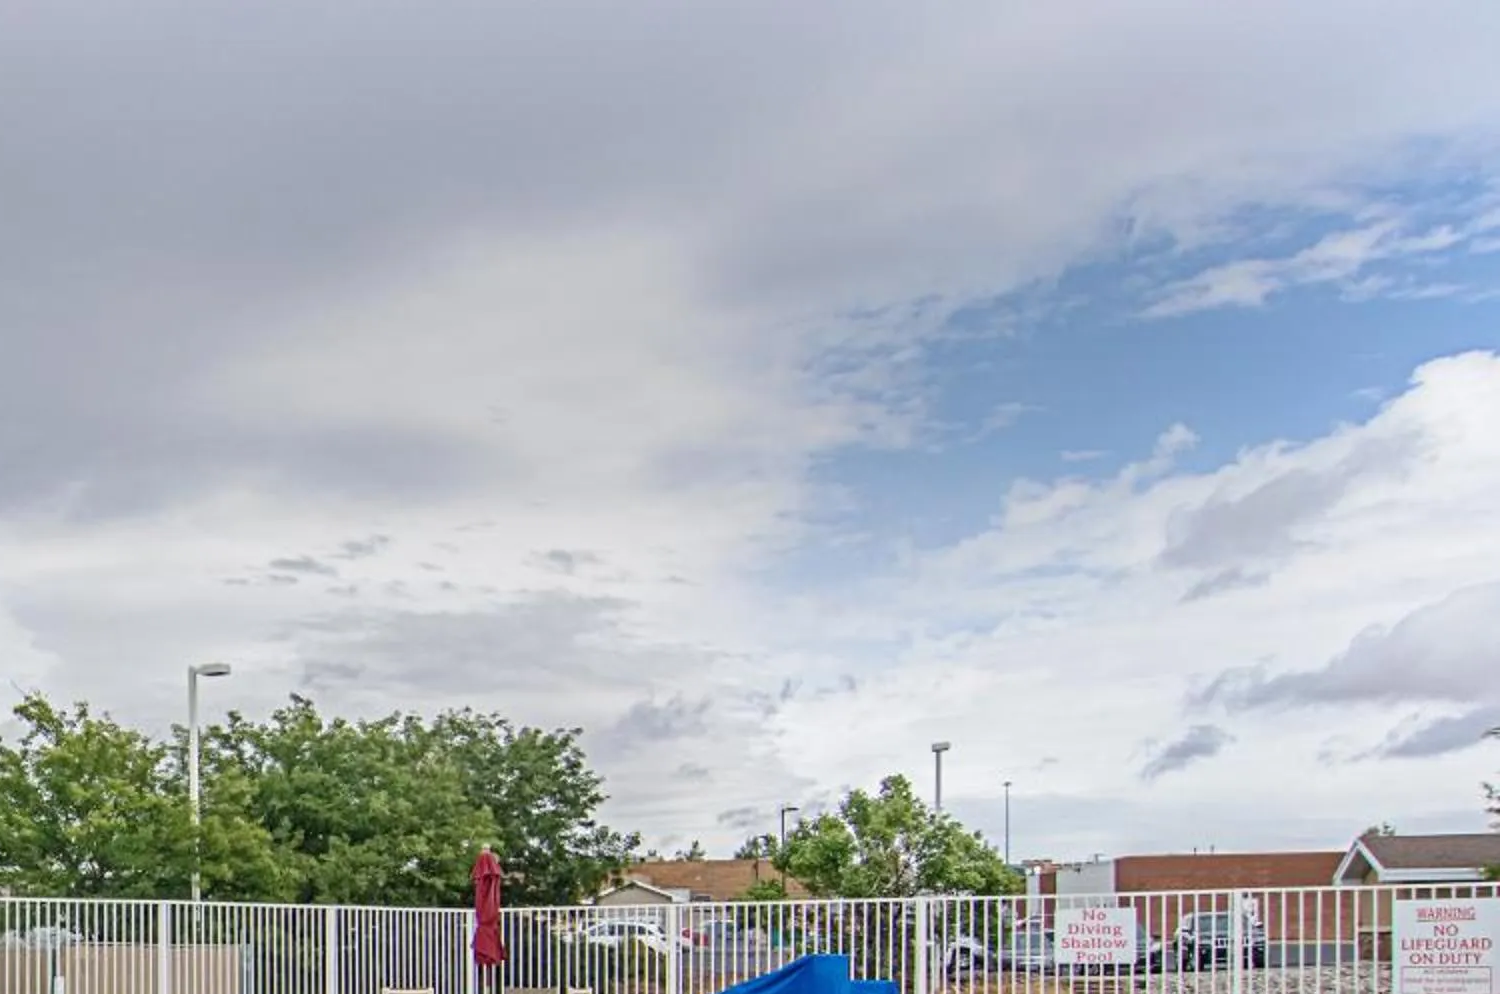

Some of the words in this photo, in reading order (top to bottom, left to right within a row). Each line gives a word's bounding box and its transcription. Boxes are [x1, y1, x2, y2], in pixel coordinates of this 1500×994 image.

[1082, 909, 1107, 921] No
[1415, 906, 1476, 921] WARNING
[1067, 923, 1123, 937] Diving
[1433, 924, 1459, 937] NO
[1061, 937, 1128, 949] Shallow
[1401, 937, 1493, 951] LIFEGUARD
[1076, 951, 1113, 962] Pool
[1409, 953, 1434, 965] ON
[1439, 952, 1483, 965] DUTY
